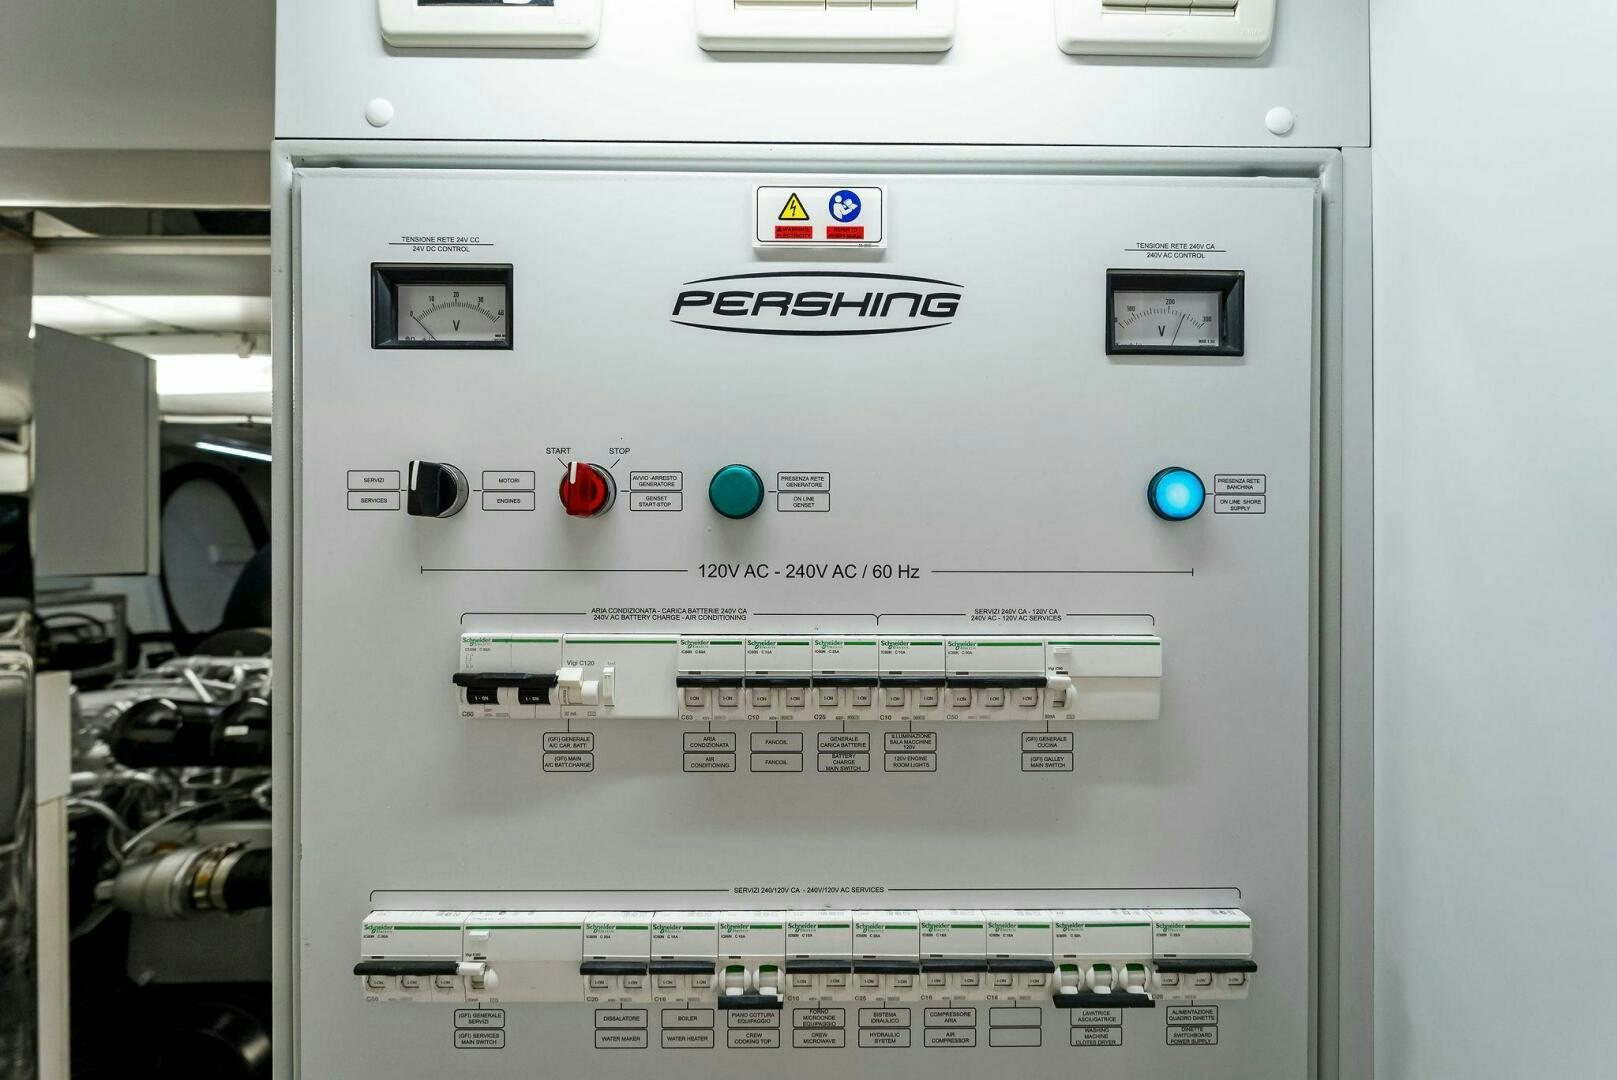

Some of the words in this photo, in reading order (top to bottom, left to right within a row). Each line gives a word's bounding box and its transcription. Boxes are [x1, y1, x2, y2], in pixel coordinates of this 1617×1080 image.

[672, 290, 962, 318] PERSHING
[452, 319, 460, 331] V
[1158, 325, 1166, 336] V
[609, 447, 631, 455] STOP
[698, 564, 740, 578] 120V
[743, 564, 769, 578] AC
[785, 564, 828, 579] 240V
[832, 564, 857, 579] AC
[872, 564, 892, 579] 60
[898, 564, 920, 579] Hz
[680, 640, 709, 648] Schneider
[747, 640, 776, 649] Schneider
[787, 922, 817, 933] Schneider
